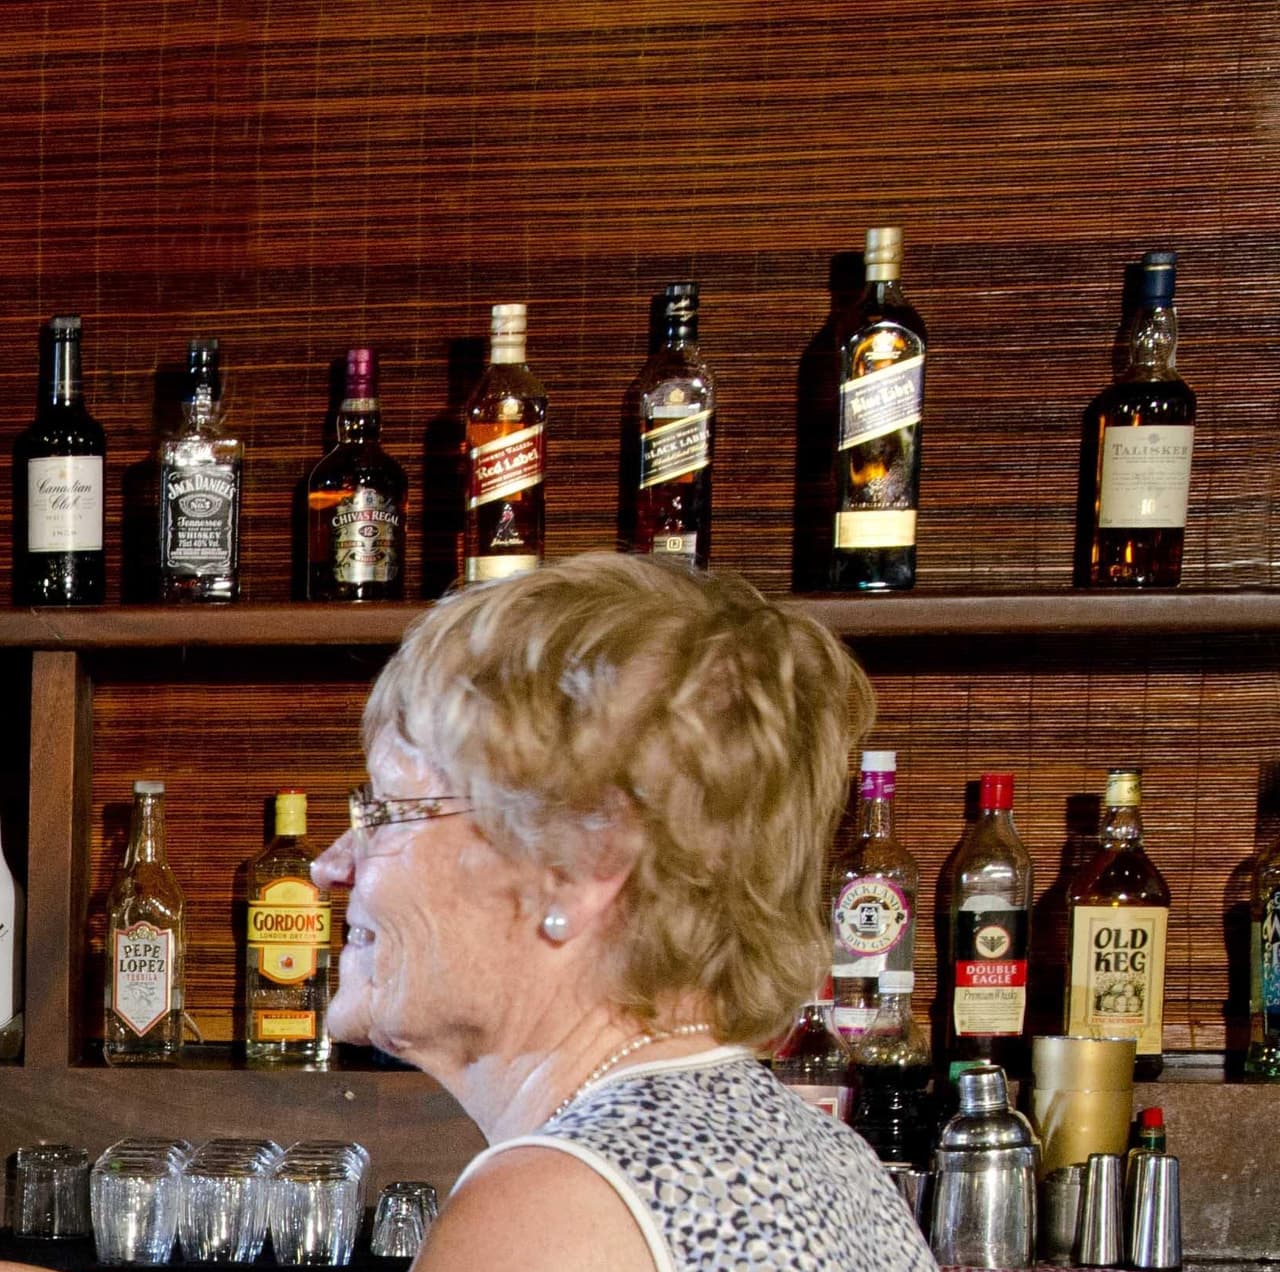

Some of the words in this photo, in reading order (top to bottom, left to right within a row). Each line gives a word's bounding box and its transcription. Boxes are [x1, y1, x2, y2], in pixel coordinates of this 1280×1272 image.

[644, 441, 678, 461] BLACK
[679, 430, 710, 448] LABEL
[1112, 443, 1187, 456] TALISKER
[476, 459, 503, 481] Red
[503, 448, 539, 471] Label
[35, 479, 92, 495] Canadian
[168, 480, 195, 500] JACK
[195, 474, 236, 501] DANIEL'S
[177, 517, 223, 526] Tennessee
[332, 511, 370, 527] CHIVAS
[372, 511, 400, 526] REGAL
[363, 526, 374, 536] 12
[842, 885, 900, 911] ROCKLAND
[253, 911, 324, 932] GORDON'S
[846, 934, 867, 949] DRY
[1095, 927, 1147, 950] OLD
[124, 944, 160, 959] PEPE
[120, 959, 165, 973] LOPEZ
[1095, 950, 1146, 973] KEG
[966, 965, 1017, 975] DOUBLE
[127, 974, 157, 982] TEQUILA
[972, 974, 1011, 984] EAGLE
